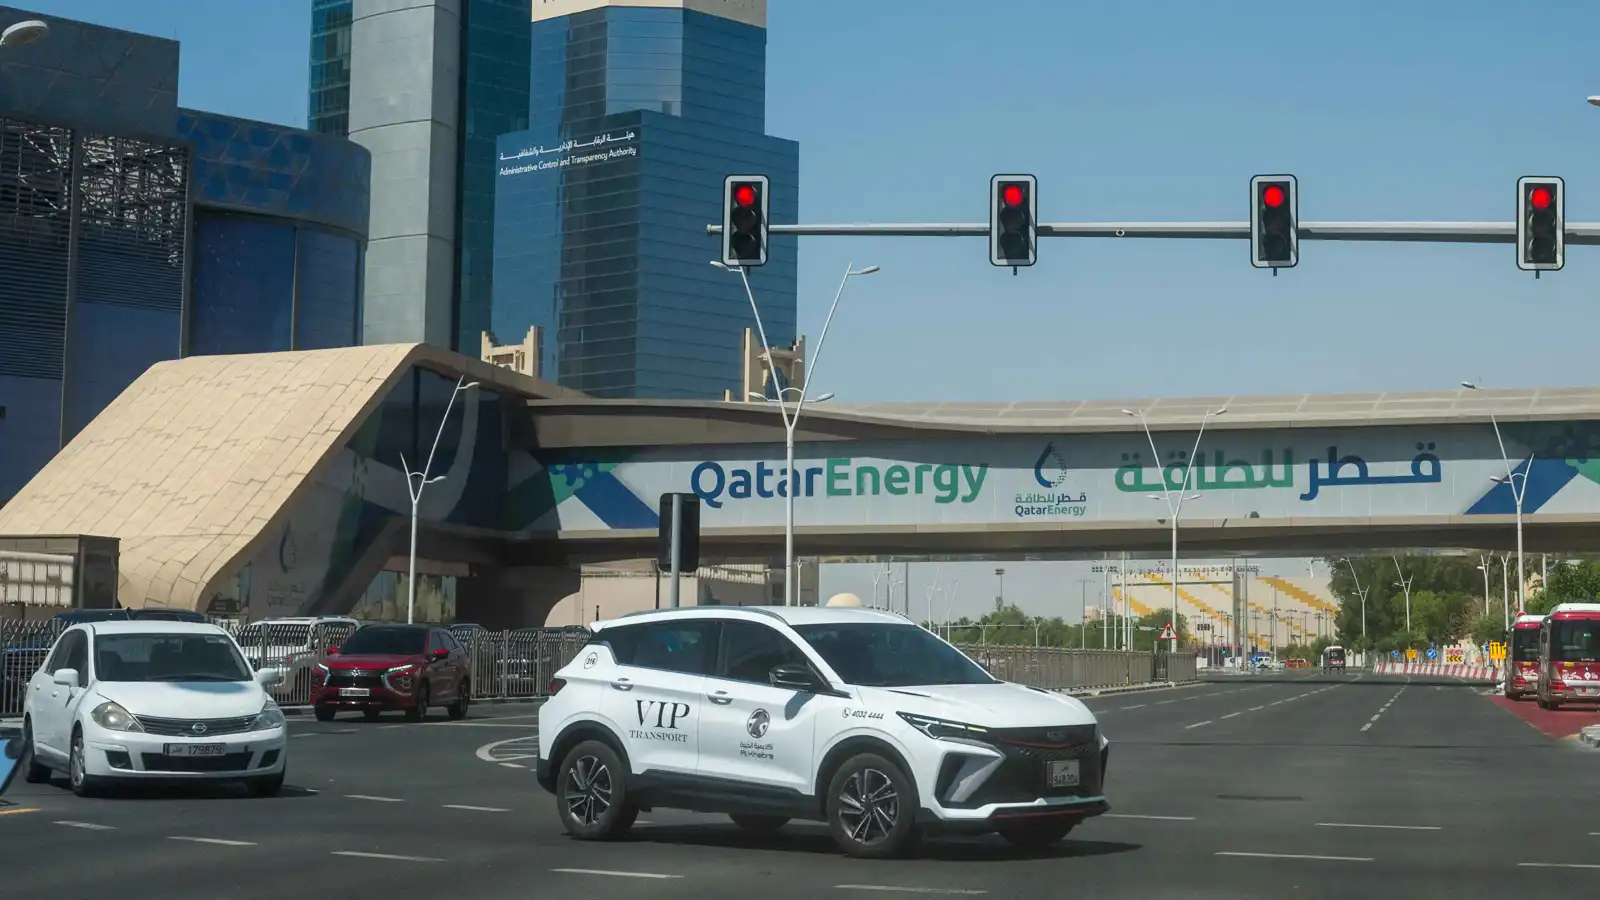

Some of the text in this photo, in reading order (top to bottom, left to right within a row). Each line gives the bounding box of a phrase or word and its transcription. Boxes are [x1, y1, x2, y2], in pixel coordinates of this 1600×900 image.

[500, 147, 636, 176] Administrative Control and Transparency Authority
[1114, 441, 1442, 501] قطر للطاقة
[690, 458, 988, 508] QatarEnergy
[1015, 491, 1087, 506] قطر للطاقة
[1014, 505, 1087, 517] QatarEnergy
[634, 699, 691, 730] VIP
[852, 710, 884, 720] 4032 4444
[628, 729, 688, 743] TRANSPORT
